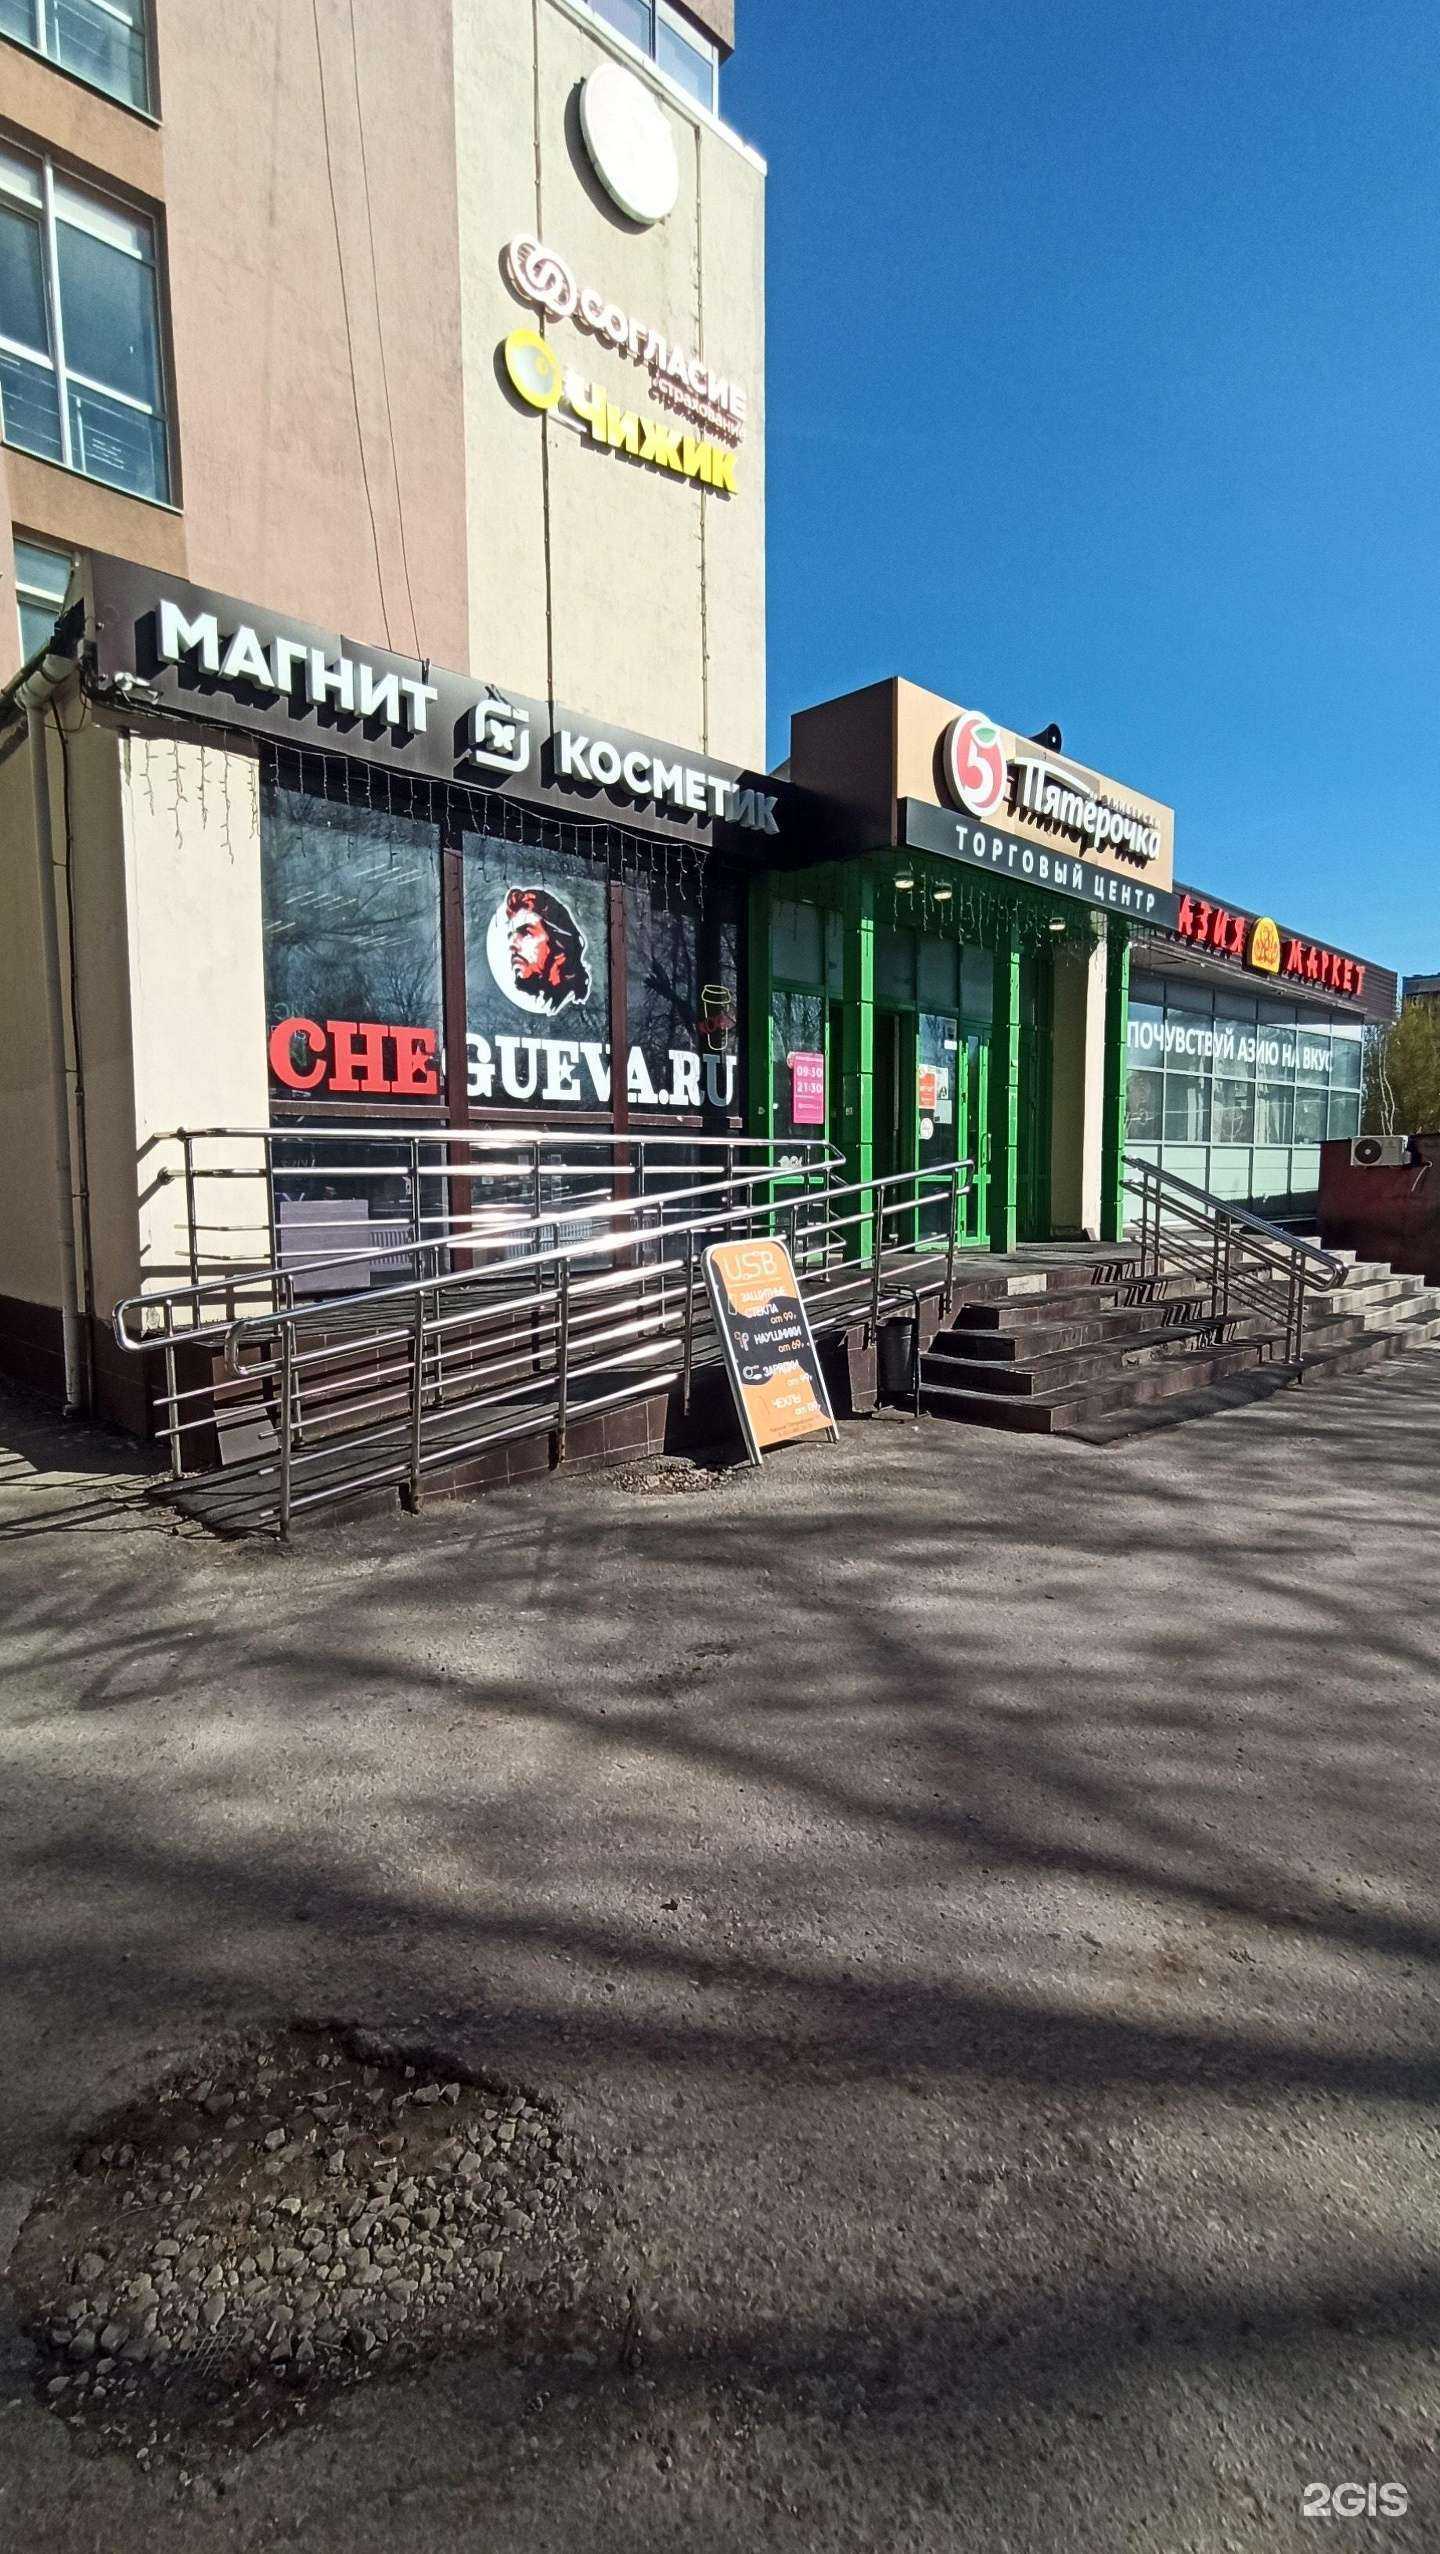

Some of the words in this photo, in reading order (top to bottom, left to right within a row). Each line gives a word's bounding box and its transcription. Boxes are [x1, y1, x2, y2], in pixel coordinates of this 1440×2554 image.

[157, 598, 438, 734] МАГНИТ
[555, 729, 780, 835] КОСМЕТИК
[956, 824, 1083, 890] ТОРГОВЫЙ
[1094, 874, 1155, 912] ЦЕНТР
[1179, 895, 1246, 953] АЗИЯ
[1287, 938, 1366, 996] МАРКЕТ
[269, 1017, 438, 1095] CHE
[1127, 1020, 1234, 1060] ПОЧУВСТВУЙ
[1237, 1036, 1280, 1066] АЗИЮ
[1281, 1043, 1301, 1068] НА
[1303, 1046, 1334, 1072] ВКУС
[722, 1249, 779, 1280] USB
